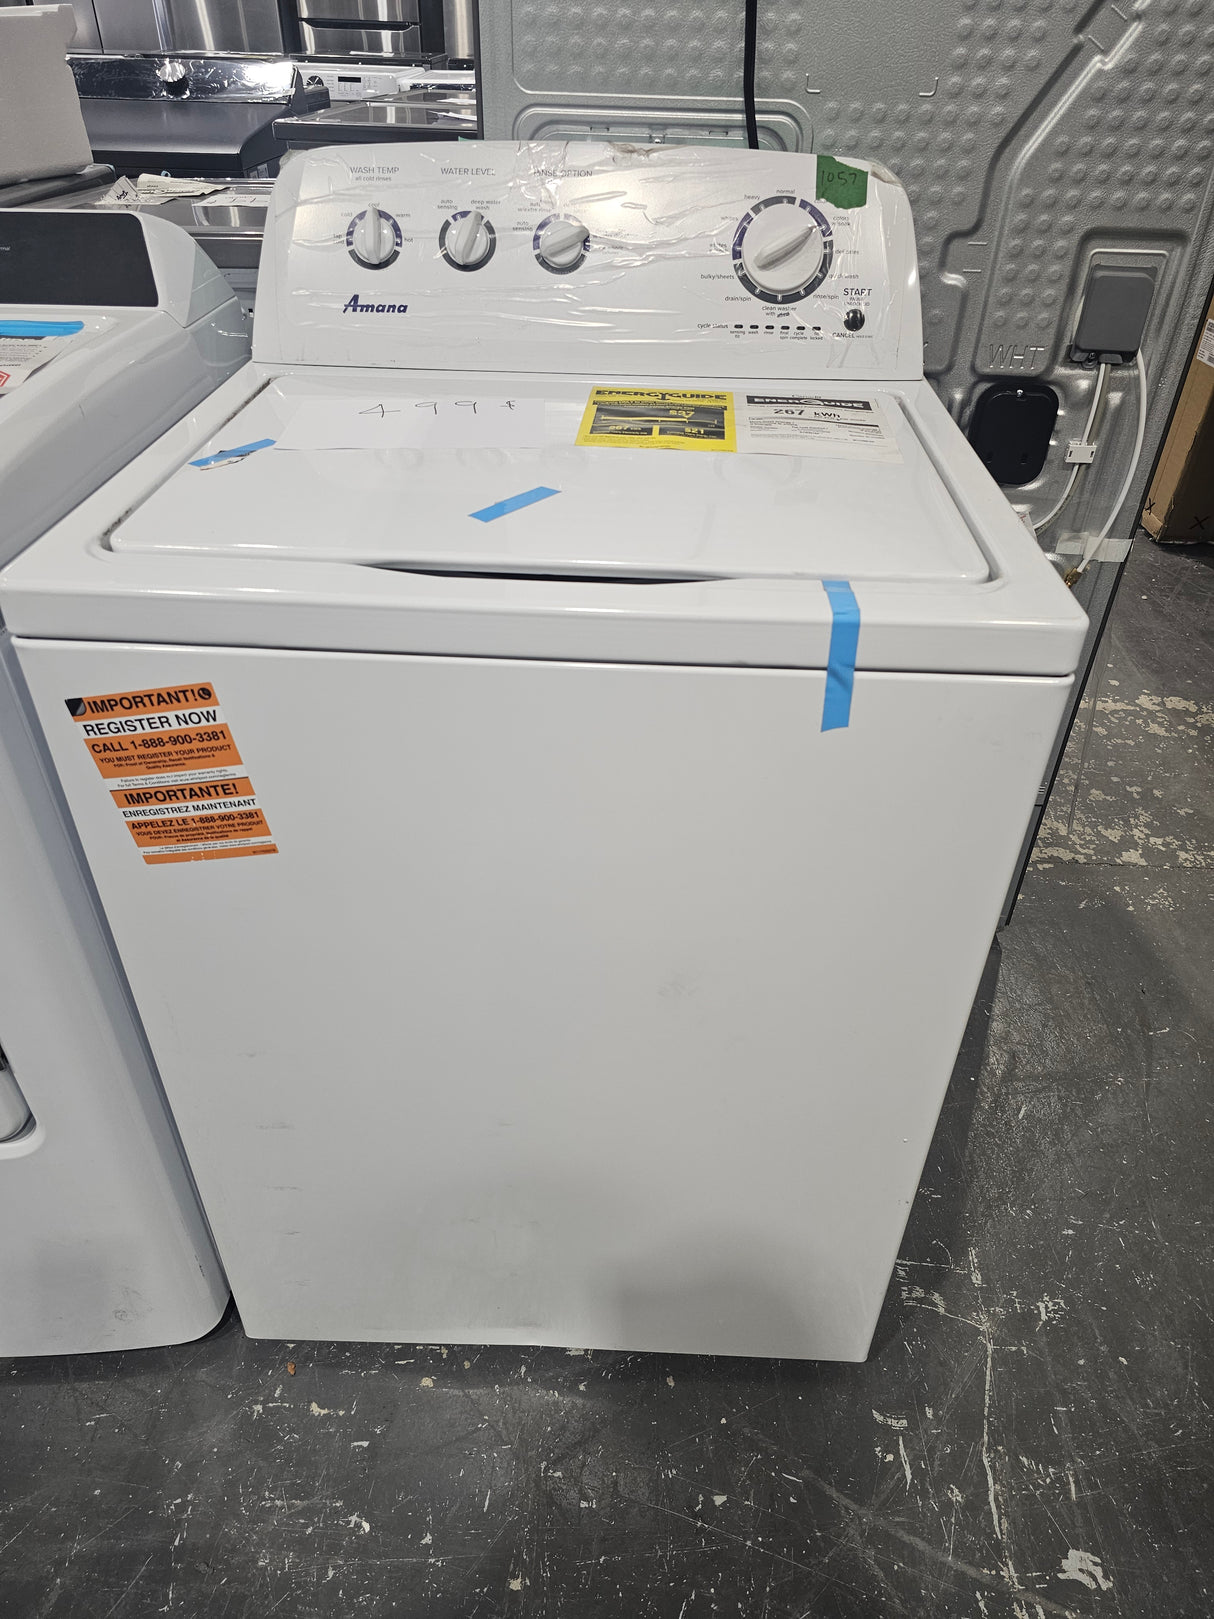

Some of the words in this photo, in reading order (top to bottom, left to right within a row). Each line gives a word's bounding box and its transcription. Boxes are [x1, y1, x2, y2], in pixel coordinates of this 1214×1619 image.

[350, 166, 375, 174] WASH
[376, 166, 400, 175] TEMP
[440, 167, 470, 175] WATER
[471, 168, 496, 176] LEVEL
[821, 169, 858, 186] 1057
[342, 294, 409, 314] Amana
[989, 343, 1048, 370] WHT
[773, 408, 805, 416] 267
[87, 688, 198, 714] IMPORTANT!
[82, 715, 172, 737] REGISTER
[174, 709, 217, 727] NOW
[91, 741, 129, 754] CALL
[130, 730, 227, 750] 1-888-900-3381
[115, 754, 136, 763] MUST
[136, 750, 174, 760] REGISTER
[174, 747, 196, 757] YOUR
[196, 743, 232, 753] PRODUCT
[124, 782, 240, 805] IMPORTANTE!
[122, 805, 191, 818] ENREGISTREZ
[192, 798, 257, 812] MAINTENANT
[131, 820, 175, 830] APPELEZ
[175, 818, 190, 827] LE
[190, 811, 260, 826] 1-888-900-3381
[173, 825, 215, 834] ENREGISTRER
[215, 822, 236, 830] VOTRE
[236, 819, 263, 828] PRODUIT
